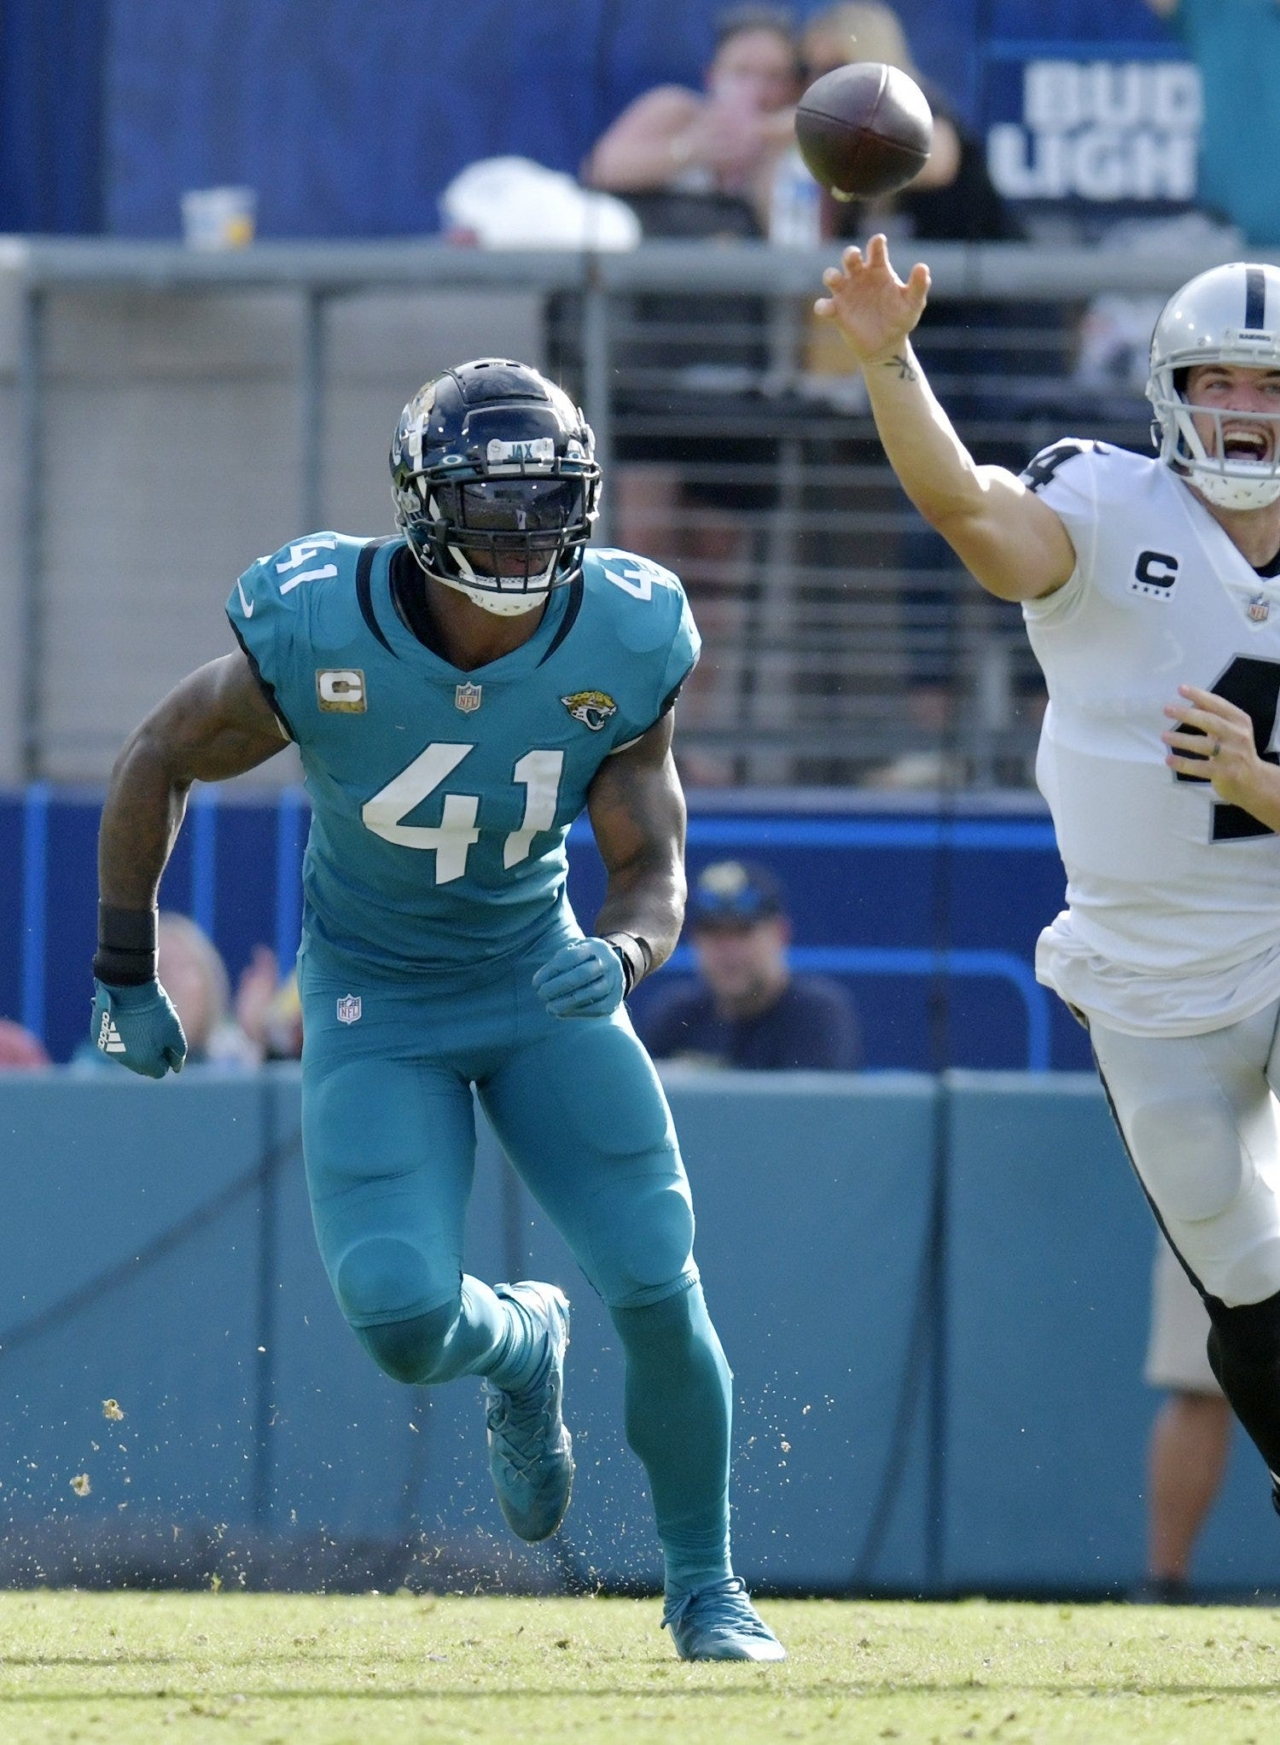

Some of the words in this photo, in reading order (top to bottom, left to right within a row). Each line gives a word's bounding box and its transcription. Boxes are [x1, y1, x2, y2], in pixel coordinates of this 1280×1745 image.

[1025, 61, 1204, 126] BUD
[986, 122, 1199, 200] LIGH
[508, 444, 533, 460] JAX
[276, 541, 338, 595] 41
[1135, 550, 1179, 588] C
[319, 671, 362, 702] C
[361, 741, 566, 885] 41
